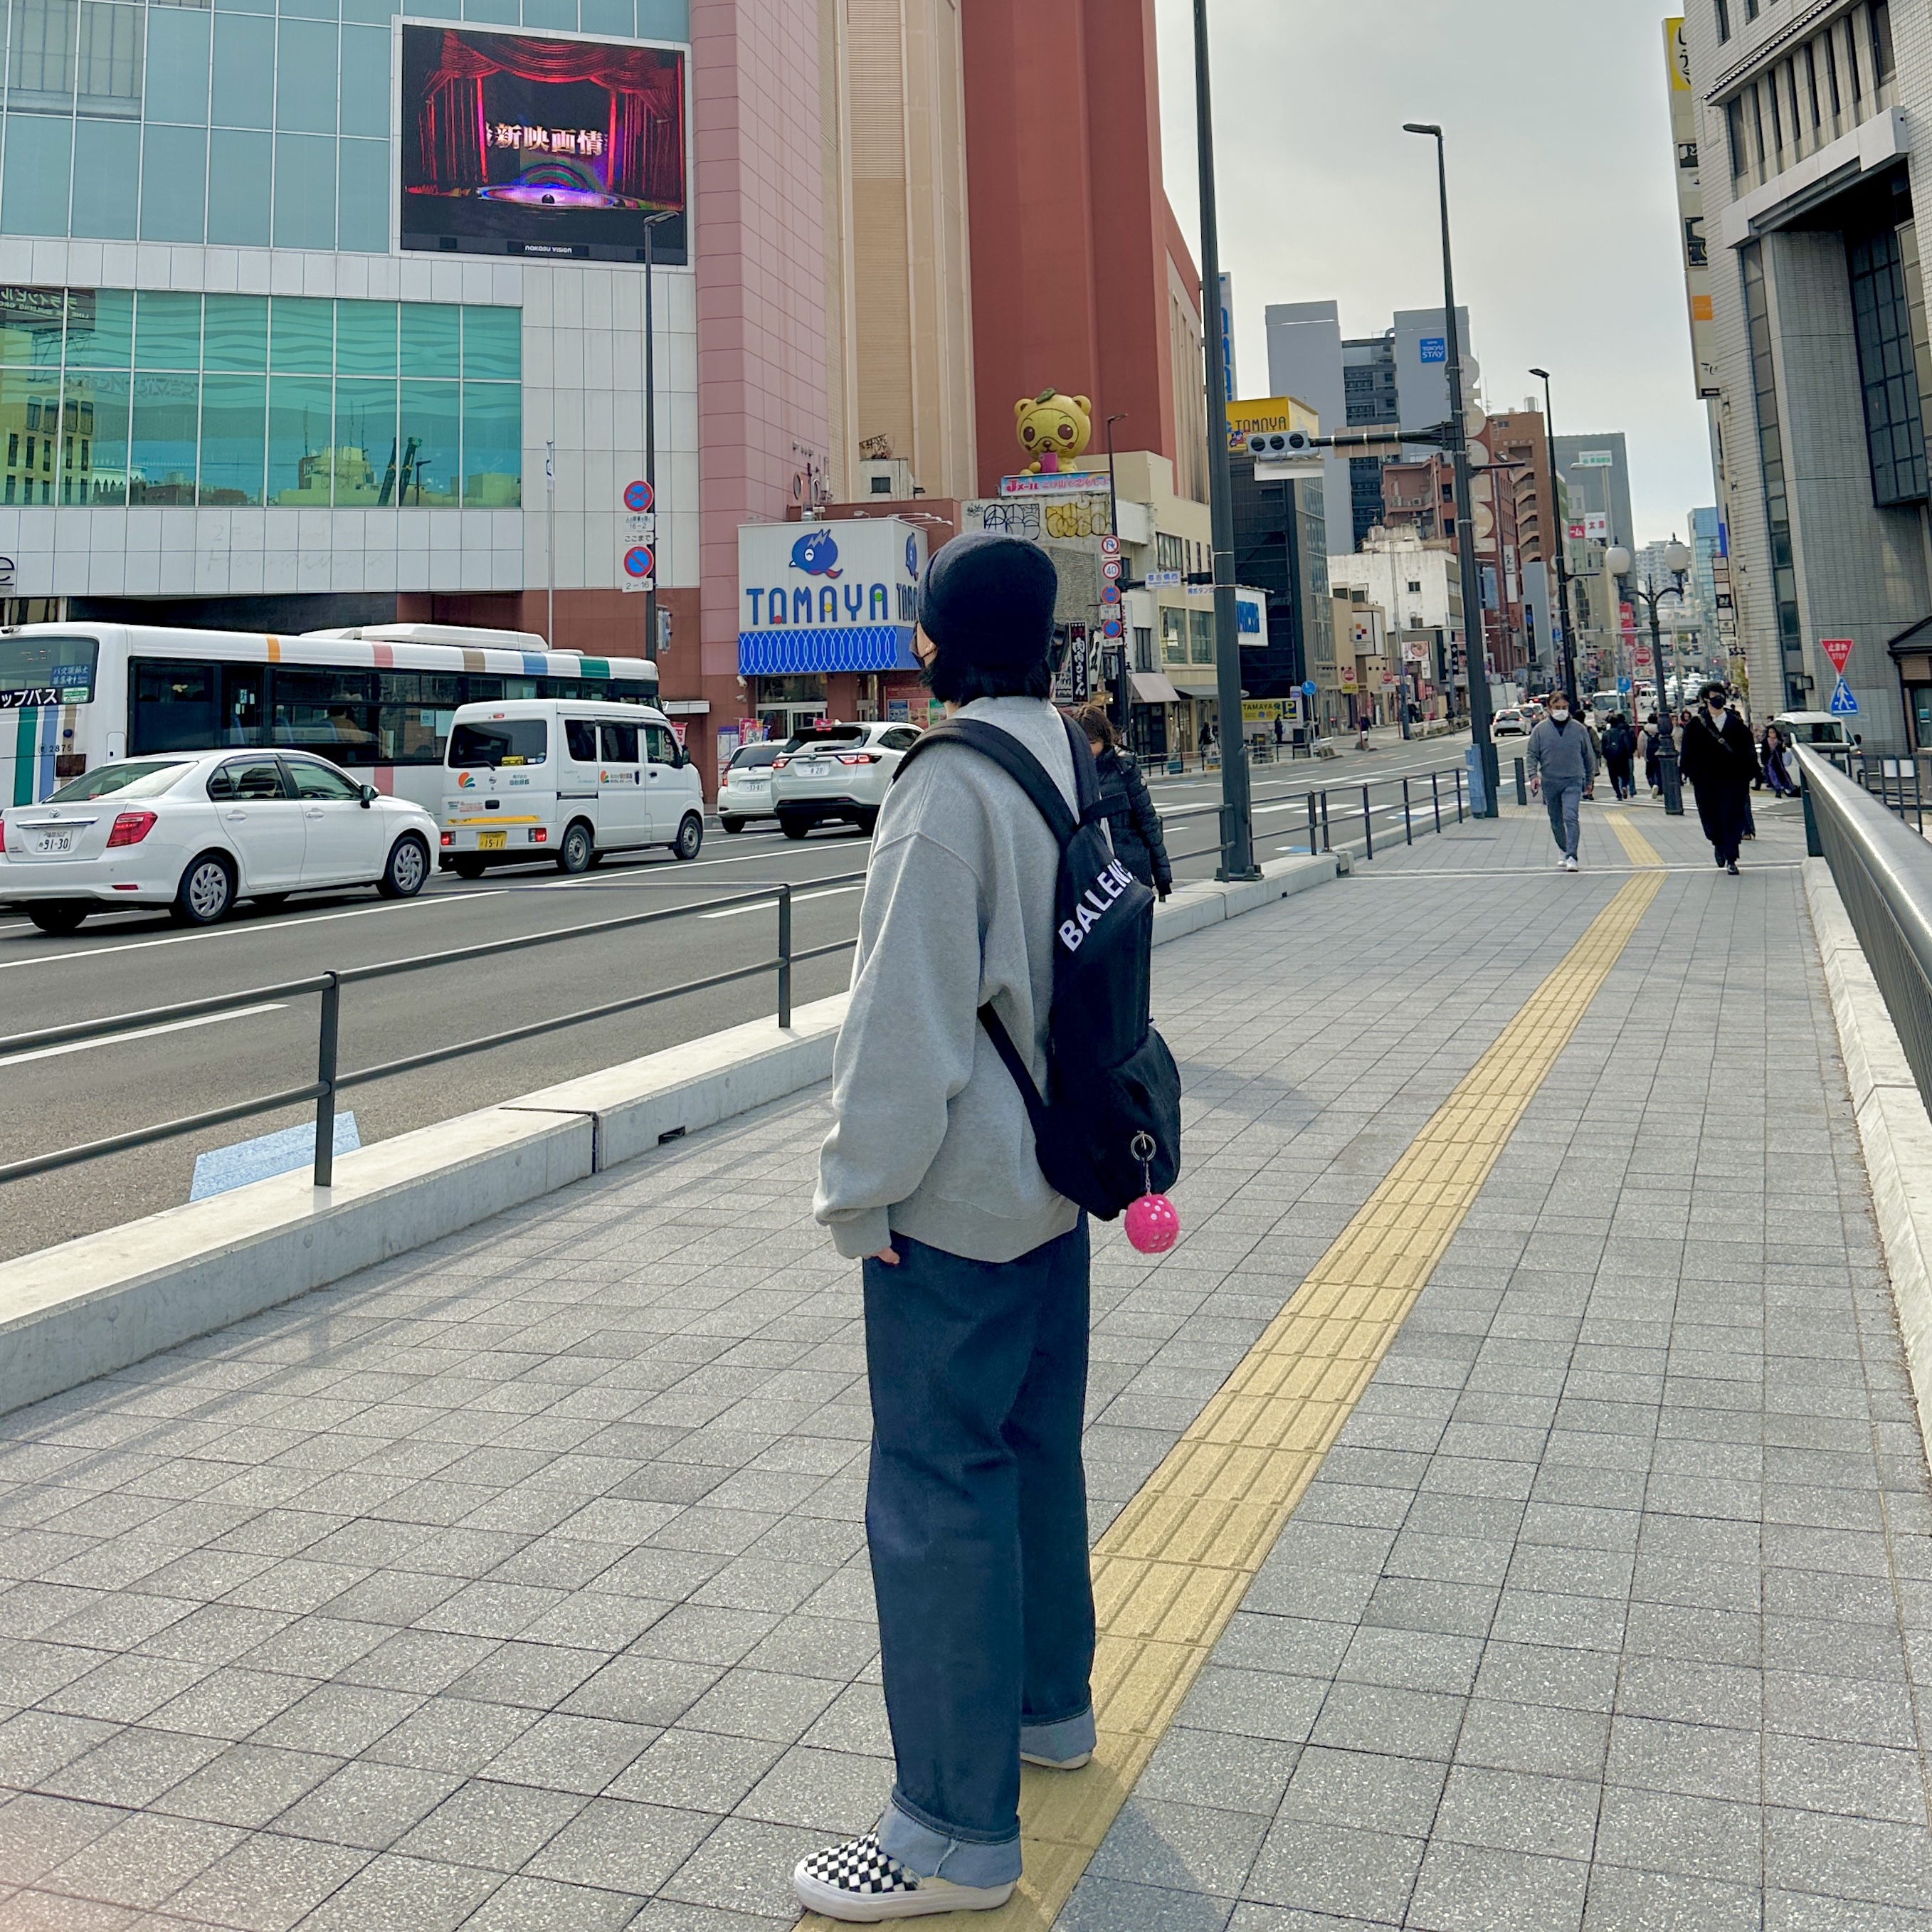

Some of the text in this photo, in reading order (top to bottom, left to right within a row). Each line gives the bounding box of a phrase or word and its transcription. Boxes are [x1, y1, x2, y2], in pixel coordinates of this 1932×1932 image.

[1235, 416, 1287, 433] TAMAYA
[624, 534, 652, 543] ここまで
[1106, 565, 1117, 575] 40
[625, 581, 650, 590] 2-16
[746, 583, 889, 625] TAMAYA
[1828, 643, 1848, 652] 止まれ
[1, 688, 57, 708] ップバス
[1285, 701, 1295, 712] P
[43, 838, 69, 850] 91-30
[485, 838, 504, 848] 15-11
